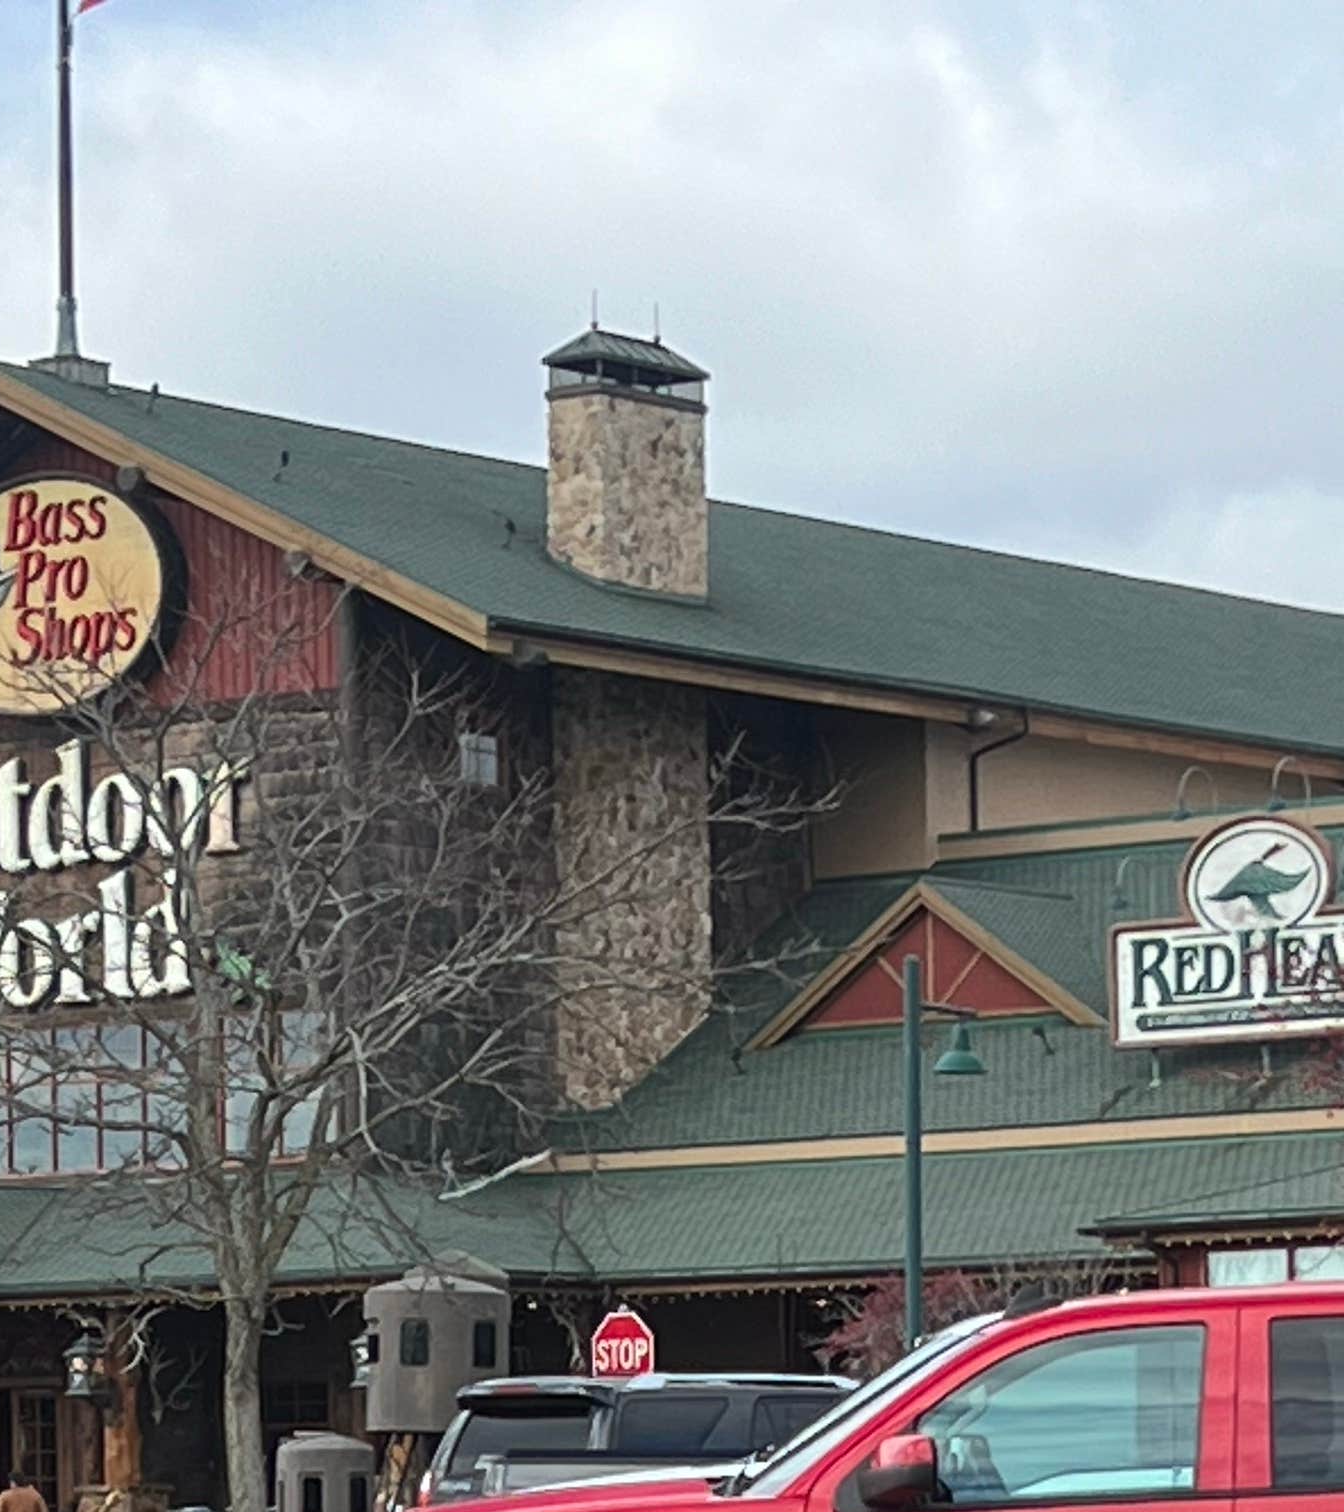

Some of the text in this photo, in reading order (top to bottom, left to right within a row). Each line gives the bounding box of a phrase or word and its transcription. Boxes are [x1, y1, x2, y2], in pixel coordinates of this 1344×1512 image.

[4, 490, 108, 551] Bass
[13, 550, 89, 609] Pro
[11, 604, 138, 667] Shops
[596, 1338, 648, 1372] STOP
